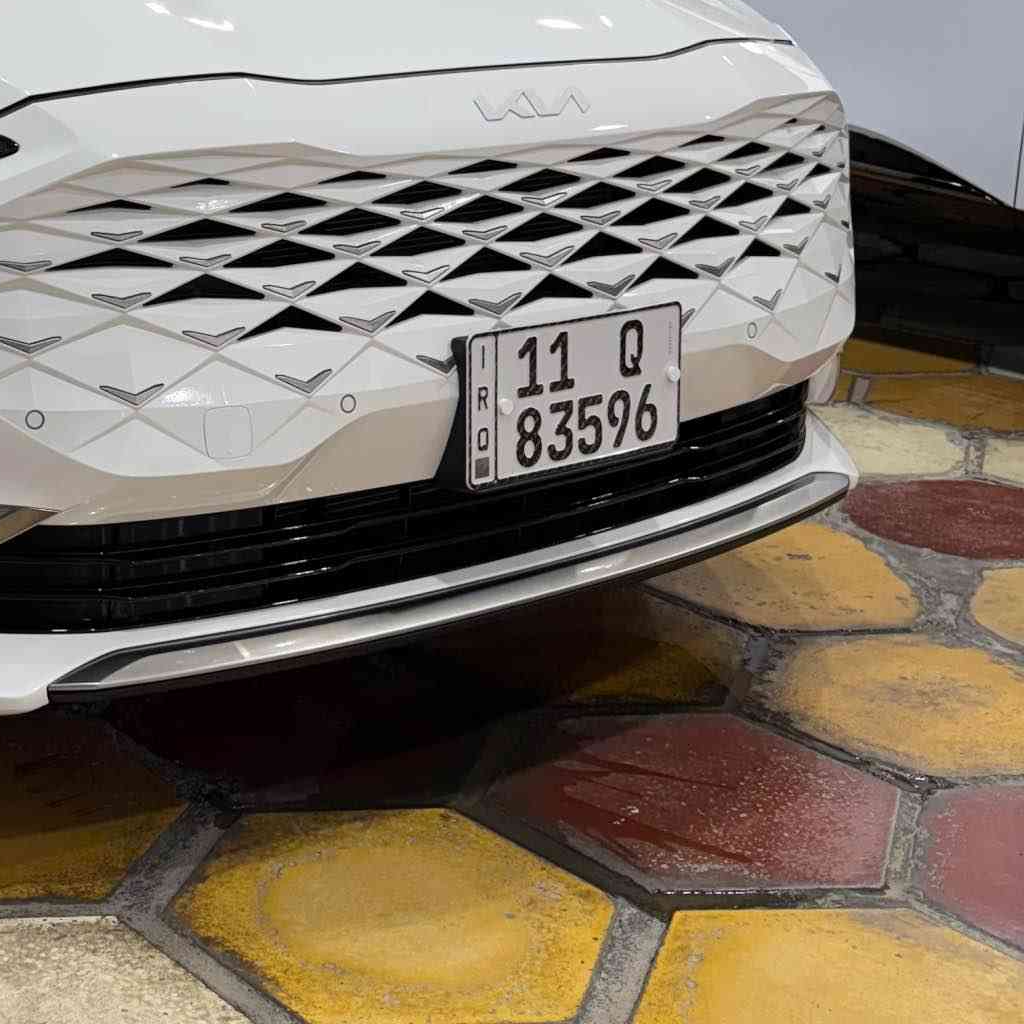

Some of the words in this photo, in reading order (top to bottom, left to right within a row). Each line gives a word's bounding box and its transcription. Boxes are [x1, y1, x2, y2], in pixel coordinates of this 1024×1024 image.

[517, 331, 575, 398] 11
[619, 319, 643, 378] Q
[515, 383, 658, 468] 83596
